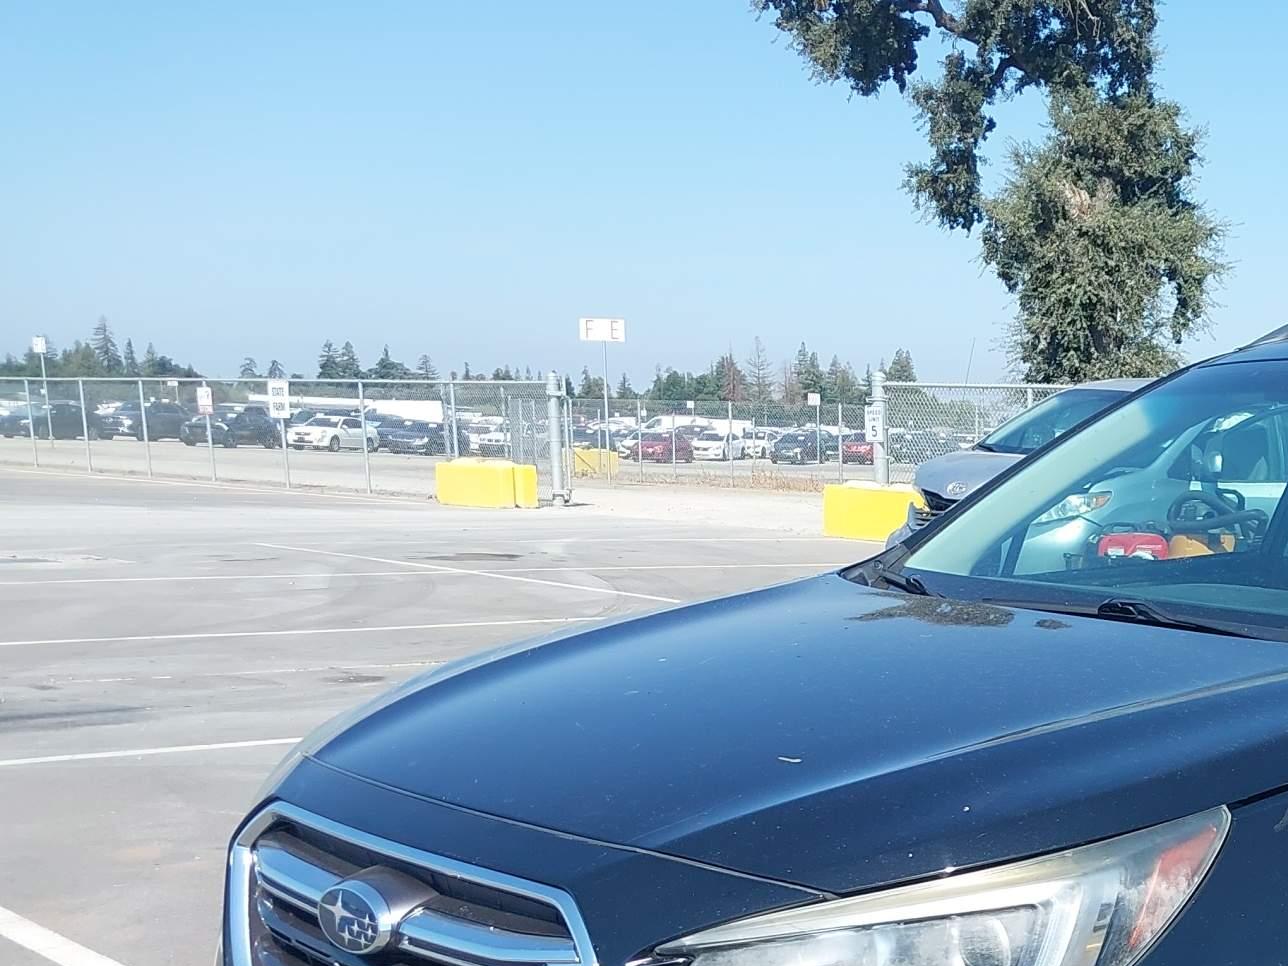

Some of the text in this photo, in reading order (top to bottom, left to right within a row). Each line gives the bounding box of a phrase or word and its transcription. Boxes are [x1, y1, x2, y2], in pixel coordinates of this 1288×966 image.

[585, 319, 620, 340] F E
[871, 425, 878, 438] 5
